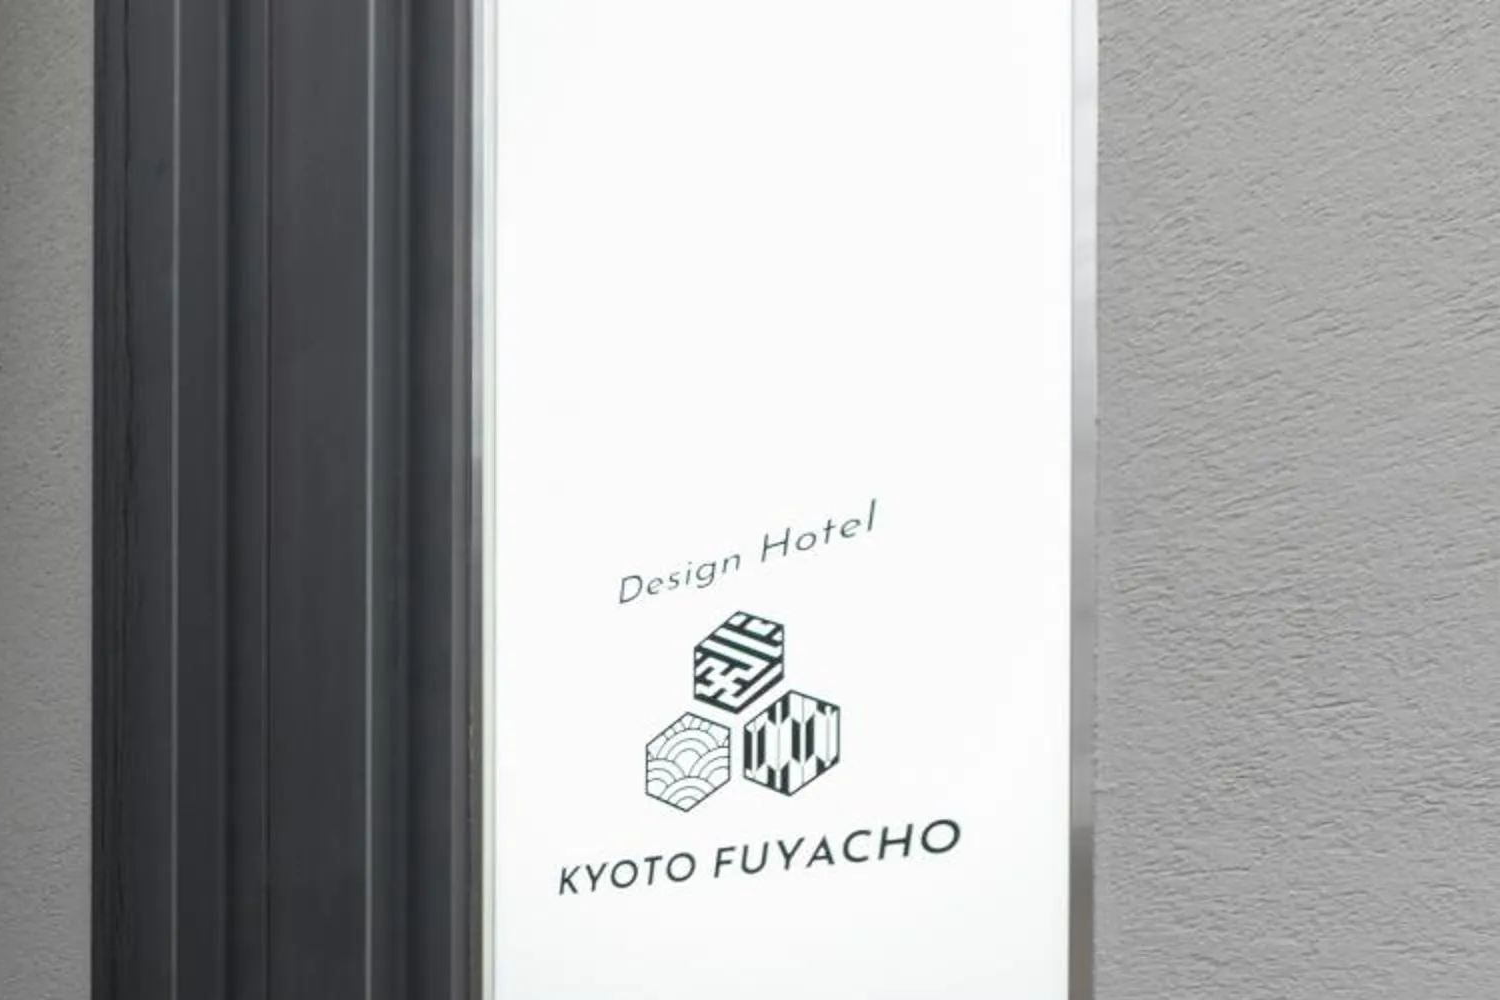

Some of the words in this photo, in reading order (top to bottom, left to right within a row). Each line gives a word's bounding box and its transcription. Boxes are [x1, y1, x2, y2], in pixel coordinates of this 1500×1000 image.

[619, 553, 741, 605] Design
[760, 498, 877, 563] Hotel
[558, 851, 697, 896] KYOTO
[713, 818, 962, 879] FUYACHO
